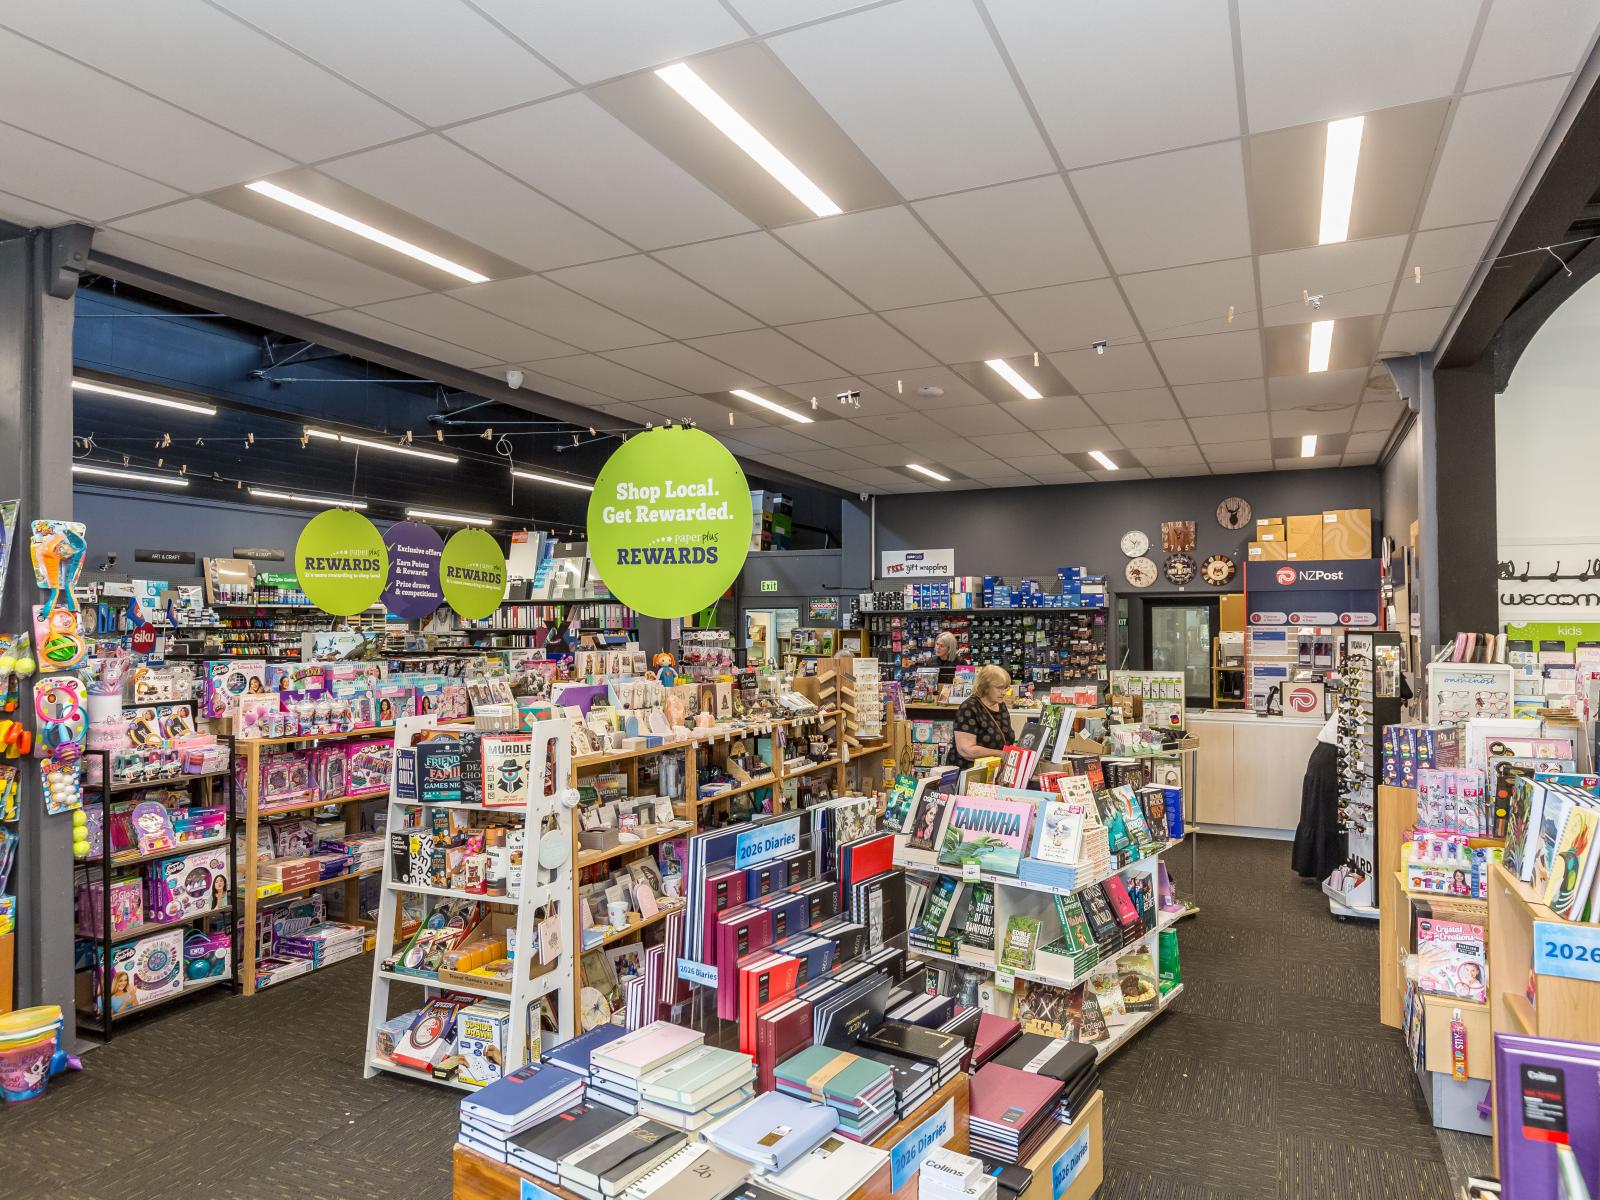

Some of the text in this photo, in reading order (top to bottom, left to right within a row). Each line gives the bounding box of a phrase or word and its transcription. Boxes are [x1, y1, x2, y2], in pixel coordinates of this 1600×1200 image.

[616, 478, 719, 503] Shop Local.
[602, 502, 734, 524] Get Rewarded.
[674, 531, 719, 545] paper plus
[397, 544, 442, 557] Exclusive offers
[617, 546, 718, 565] REWARDS
[305, 557, 380, 571] REWARDS
[396, 558, 430, 569] Earn Points
[886, 563, 948, 575] FREE gift wrapping
[402, 568, 428, 577] Rewards
[446, 565, 502, 585] REWARDS
[1299, 570, 1344, 581] NZPost
[395, 580, 431, 590] Prize draws
[761, 581, 777, 591] Exit
[394, 588, 438, 598] & competitions
[134, 631, 155, 643] siku
[1557, 626, 1583, 636] kids
[488, 744, 531, 755] MURDLE
[398, 757, 414, 770] DAILY
[426, 755, 460, 768] FRIEND
[398, 771, 414, 785] QUIZ
[429, 766, 460, 781] FAMI
[461, 771, 481, 779] CHO
[954, 806, 1021, 837] TANIWHA
[740, 833, 796, 860] 2026 Diaries
[982, 893, 993, 904] THE
[976, 902, 994, 915] SPIRIT
[974, 913, 992, 926] OF THE
[965, 921, 995, 937] RAINFORES
[1435, 925, 1463, 935] Crystal
[1439, 932, 1475, 941] Creations
[1545, 941, 1600, 963] 2026
[679, 965, 717, 982] 2026 Diaries
[1082, 1000, 1099, 1010] althy
[1083, 1009, 1099, 1021] High
[465, 1021, 493, 1032] UPSIDE
[1080, 1020, 1105, 1031] Protein
[1527, 1070, 1557, 1083] Collins
[894, 1121, 947, 1175] 2026 Diaries
[692, 1163, 712, 1179] 26
[925, 1159, 966, 1179] Collins
[1053, 1141, 1088, 1188] 2026 Diaries
